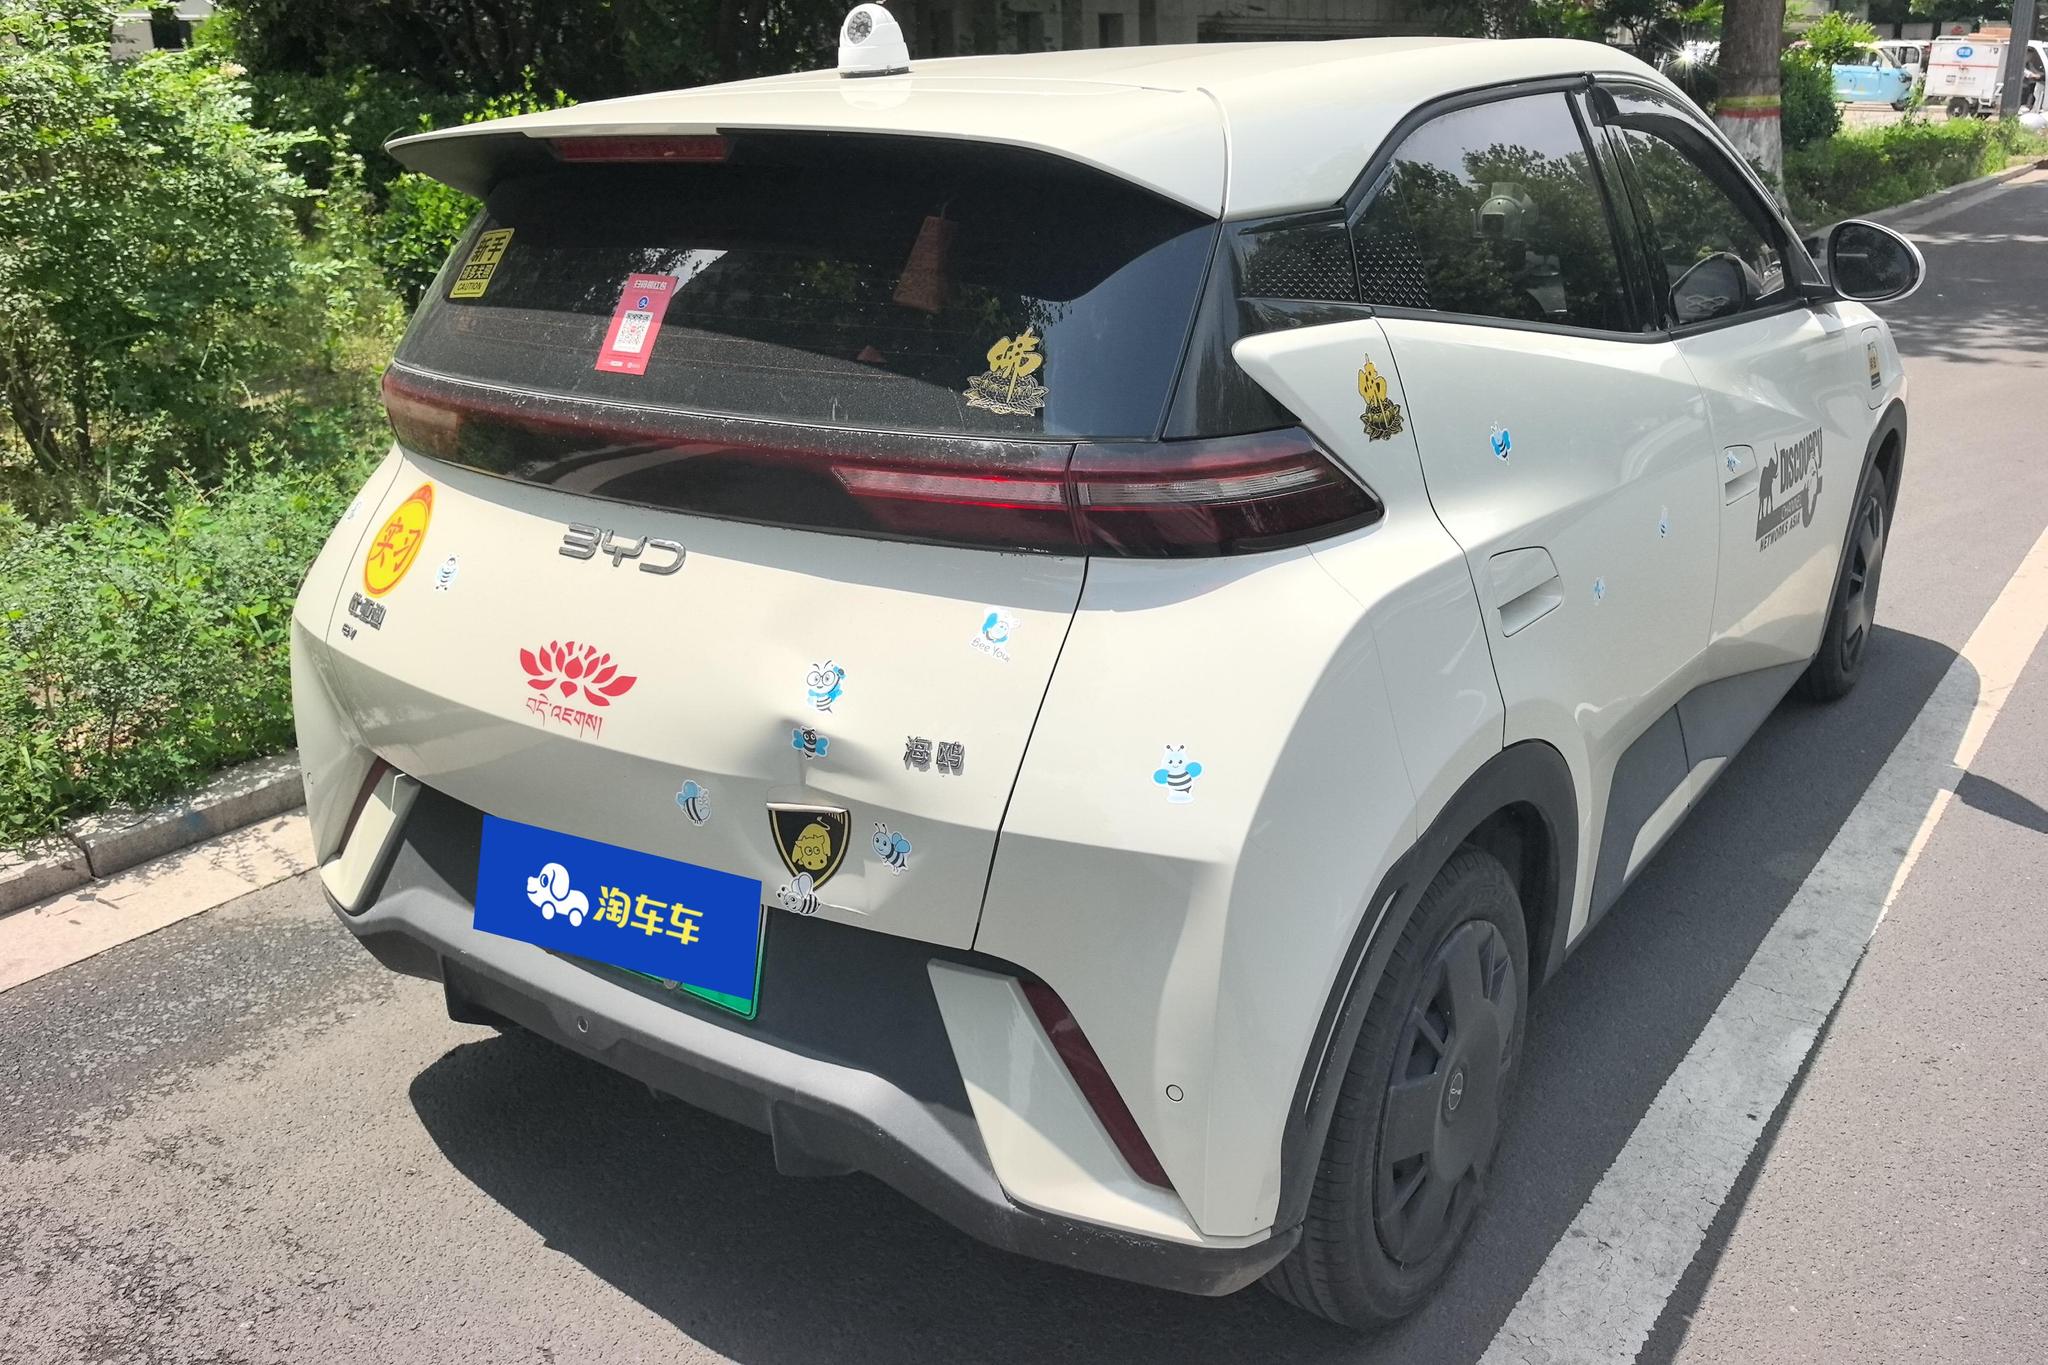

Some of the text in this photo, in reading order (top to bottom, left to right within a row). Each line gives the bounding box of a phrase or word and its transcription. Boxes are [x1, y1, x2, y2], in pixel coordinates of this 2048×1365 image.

[471, 236, 507, 262] 新手
[370, 516, 421, 573] 实习
[559, 522, 686, 576] BYD
[903, 735, 966, 774] 海鸥
